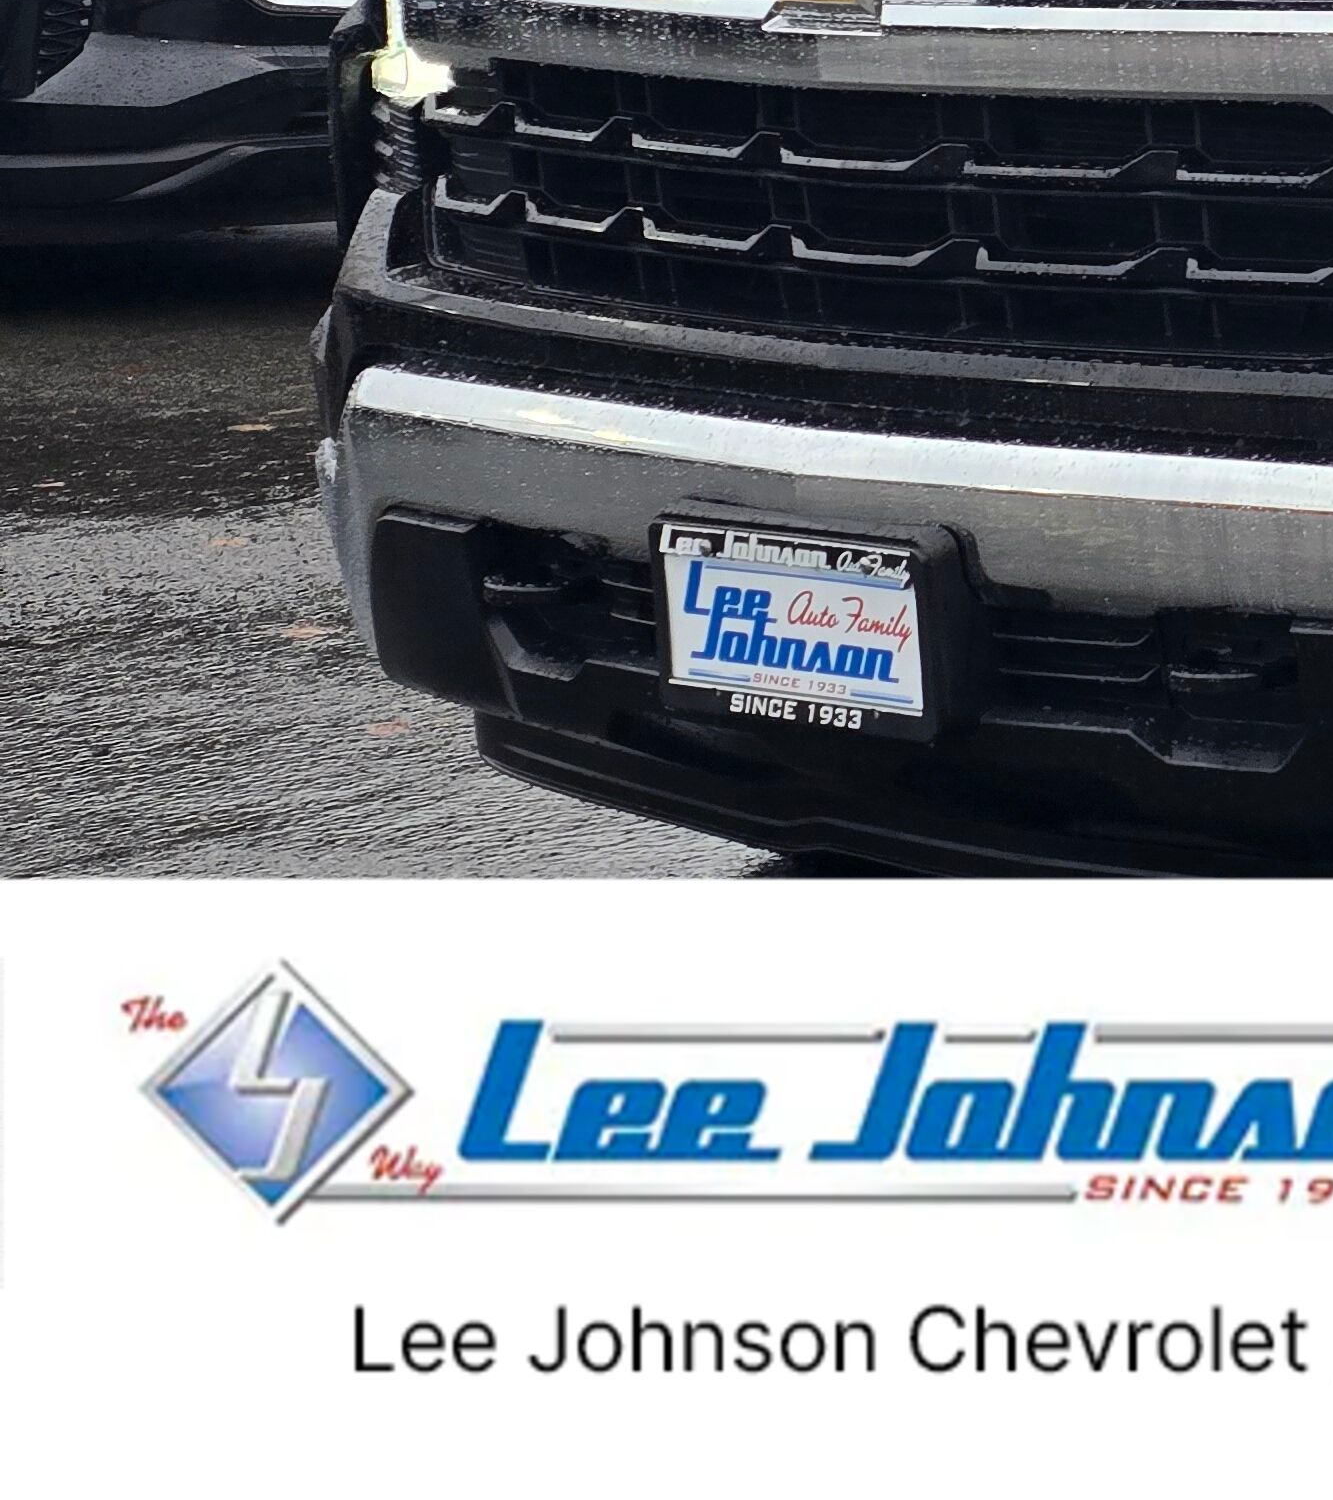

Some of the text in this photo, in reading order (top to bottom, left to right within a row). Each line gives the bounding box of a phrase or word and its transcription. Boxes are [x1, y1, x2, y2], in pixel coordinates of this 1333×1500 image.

[716, 530, 831, 572] Johnson
[683, 560, 912, 653] Lee Auto Family
[690, 606, 899, 684] Johnson
[752, 672, 847, 695] SINCE 1933
[729, 693, 862, 731] SINCE 1933
